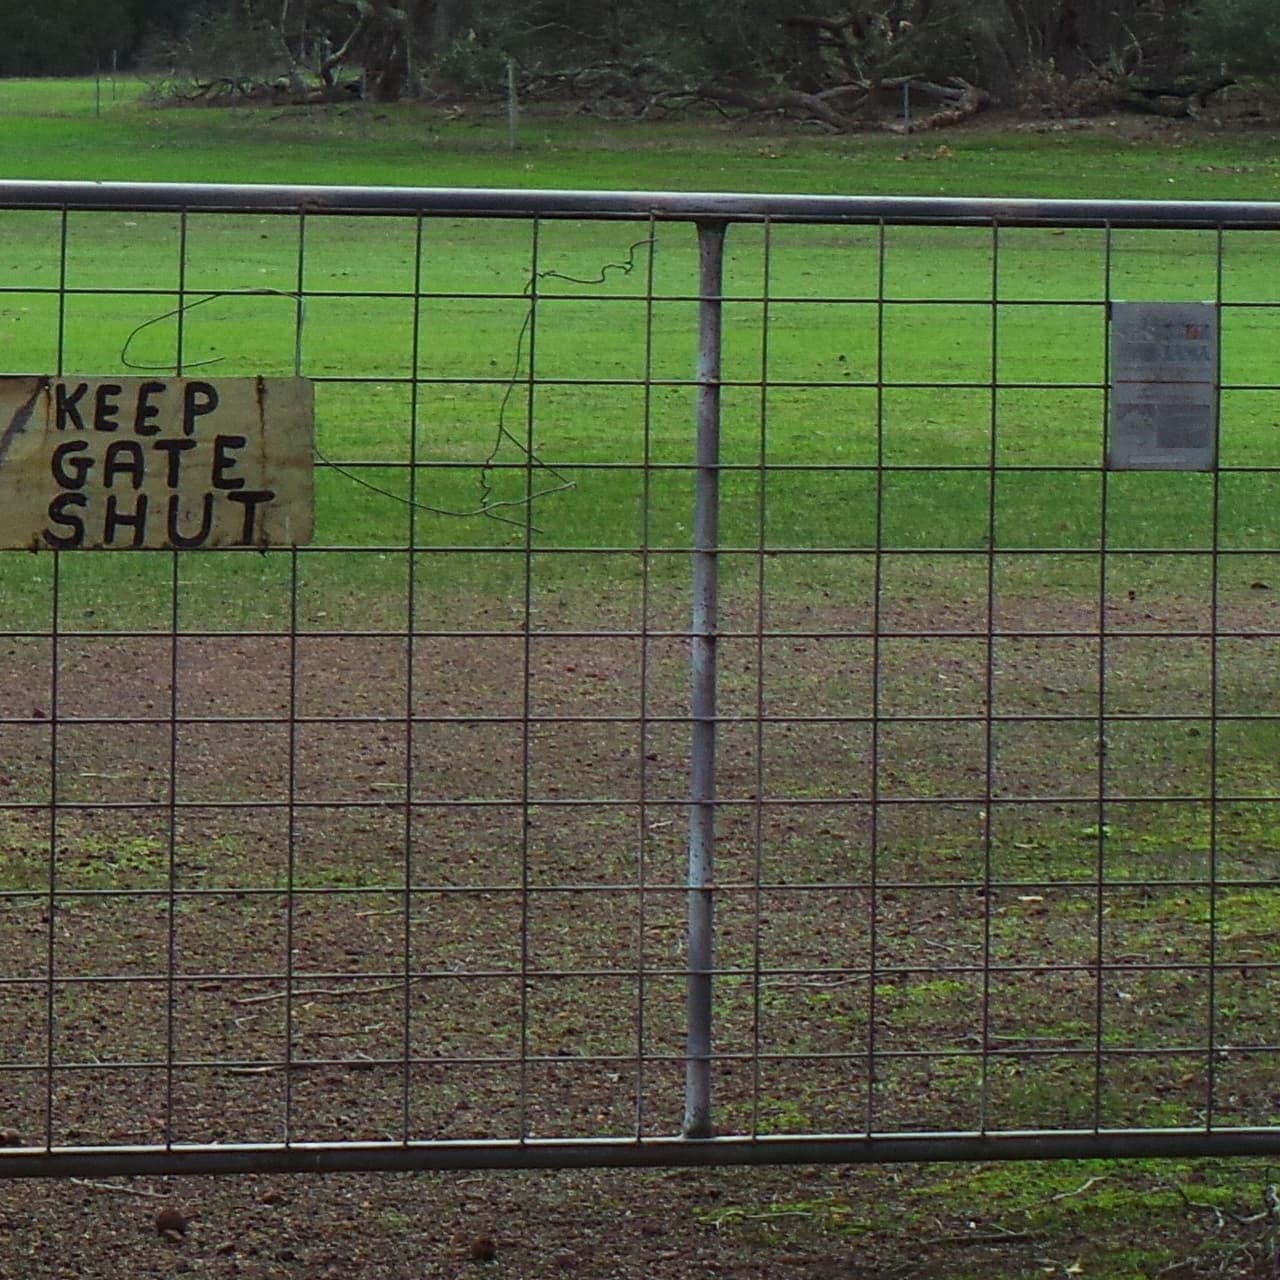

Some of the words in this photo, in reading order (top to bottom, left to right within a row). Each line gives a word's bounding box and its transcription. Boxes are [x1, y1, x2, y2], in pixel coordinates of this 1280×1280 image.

[55, 381, 219, 436] KEEP
[51, 434, 246, 490] GATE
[42, 490, 276, 548] SHUT
